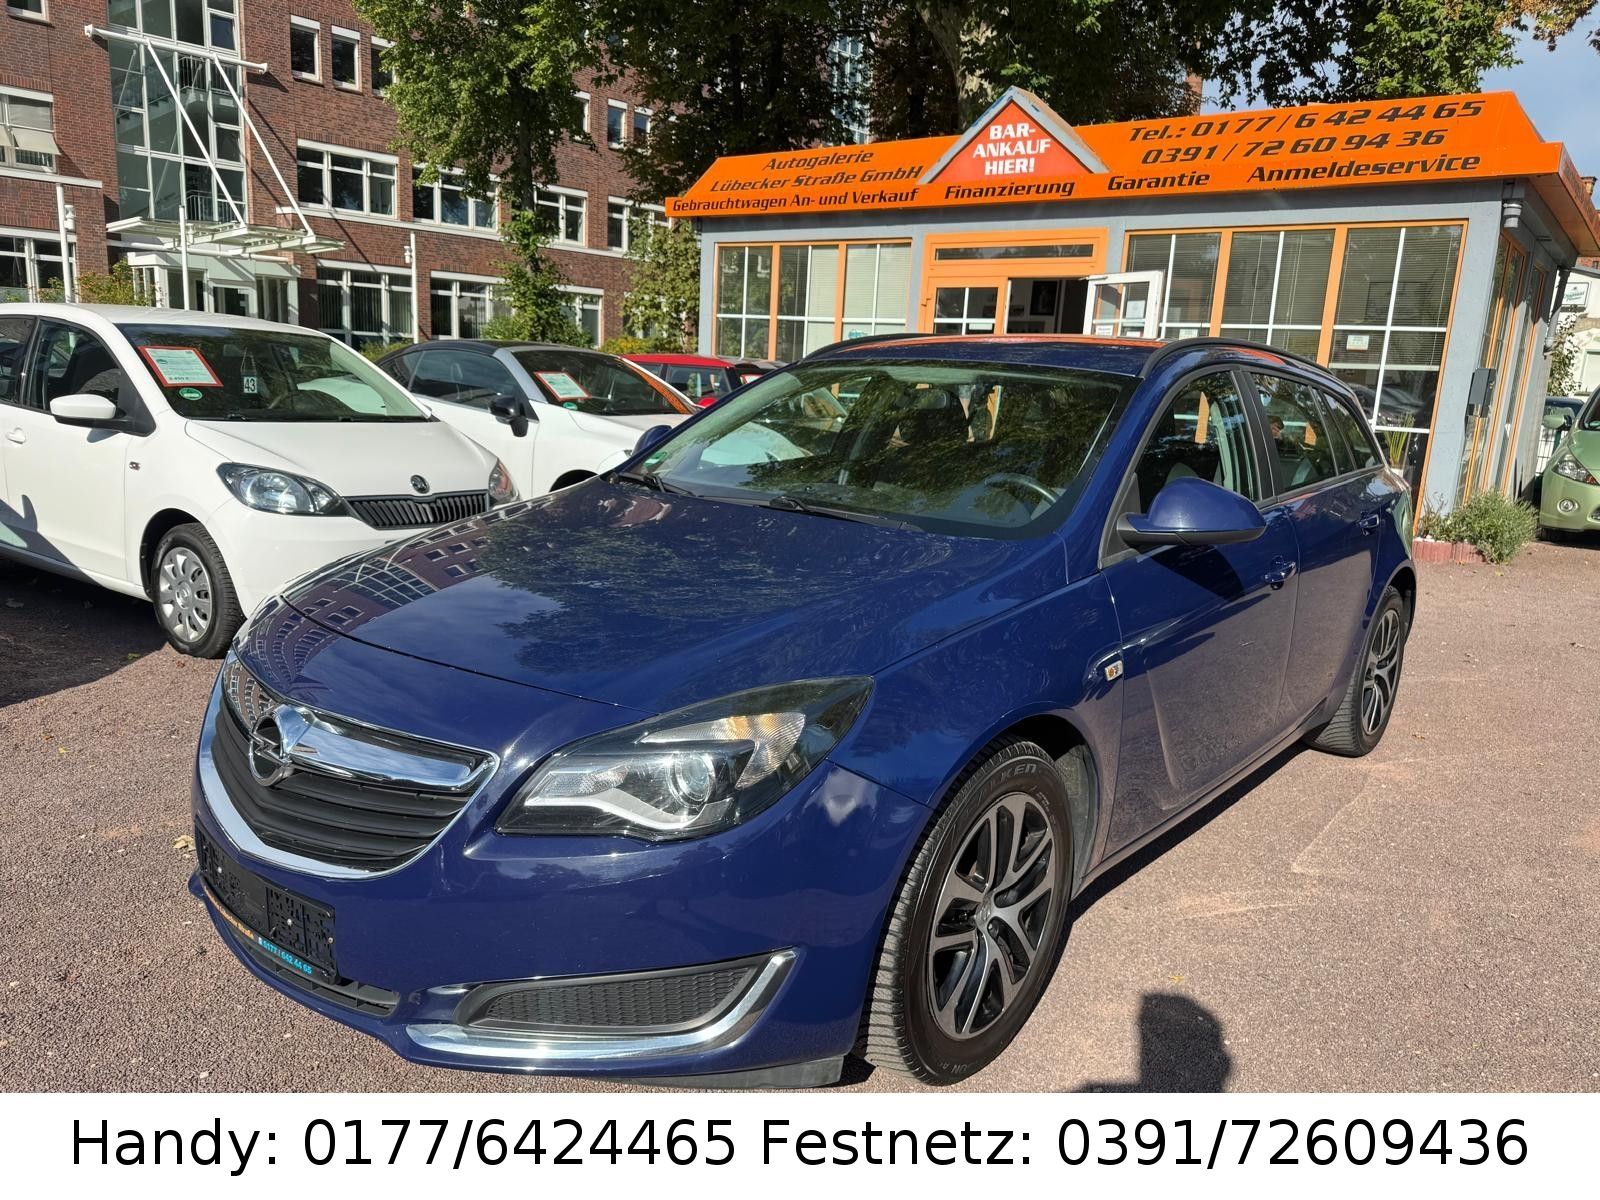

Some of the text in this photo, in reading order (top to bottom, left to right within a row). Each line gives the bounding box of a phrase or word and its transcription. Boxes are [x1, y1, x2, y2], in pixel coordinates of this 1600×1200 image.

[1129, 125, 1187, 141] Tel.:
[1191, 116, 1277, 137] 0177
[1295, 113, 1319, 128] 6
[1323, 109, 1371, 126] 42
[1376, 105, 1427, 122] 44
[1432, 101, 1486, 119] 65
[989, 123, 1036, 140] BAR-
[972, 138, 1052, 158] ANKAUF
[1141, 145, 1218, 164] 0391
[1243, 140, 1285, 157] 72
[1290, 136, 1337, 154] 60
[1341, 132, 1390, 150] 94
[1395, 128, 1448, 147] 36
[762, 150, 874, 171] Autogalerie
[984, 158, 1035, 175] HIER!
[1247, 154, 1480, 183] Anmeldeservice
[710, 165, 923, 193] Lübecker Straße GmbH
[1107, 171, 1210, 191] Garantie
[672, 188, 919, 211] Gebrauchtwagen An- und Verkauf
[944, 182, 1075, 199] Finanzierung
[244, 377, 256, 392] 43
